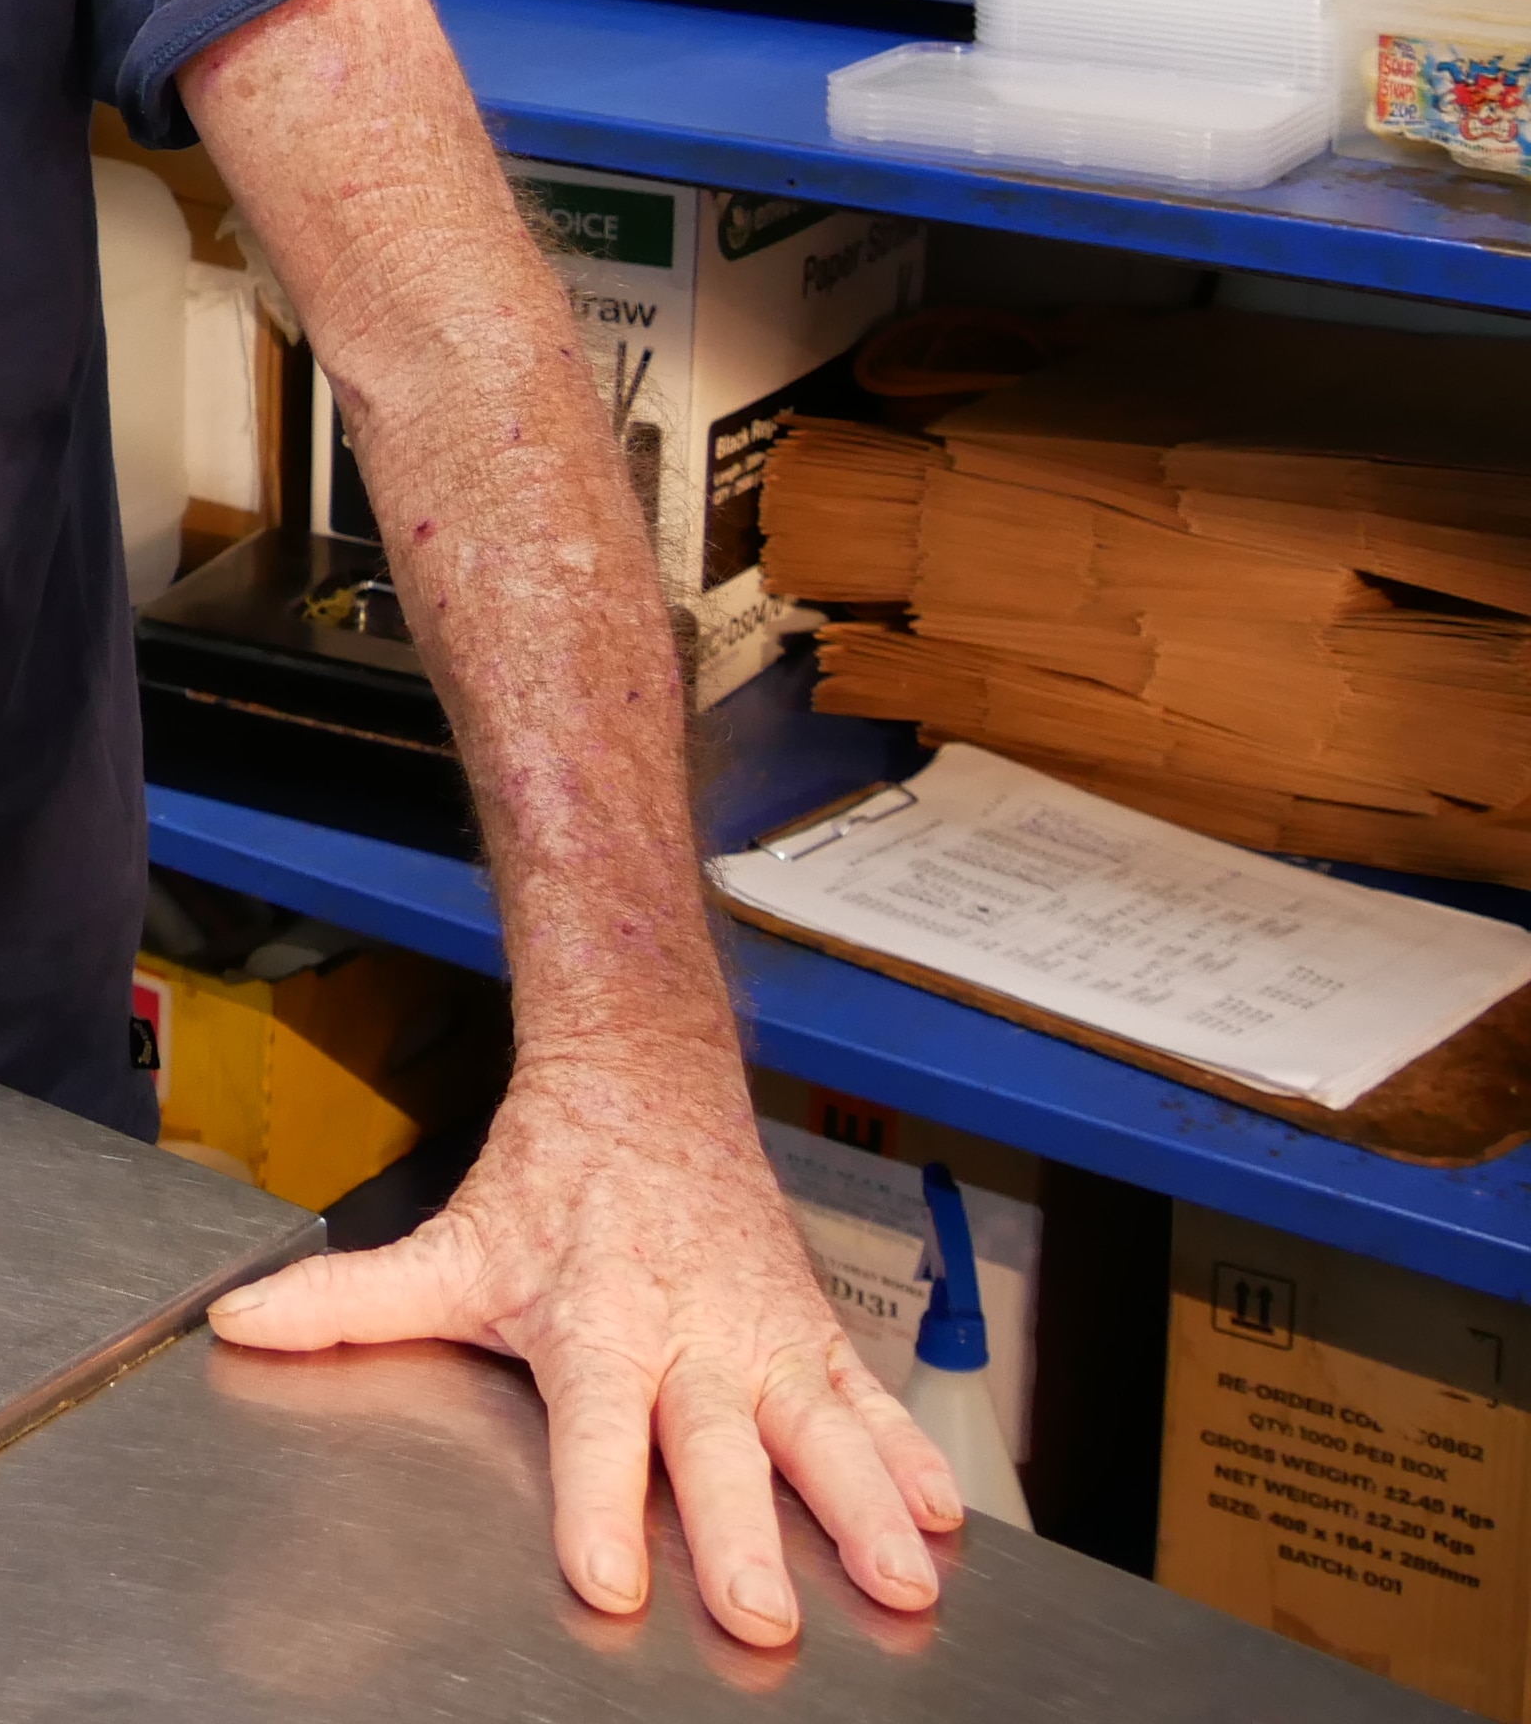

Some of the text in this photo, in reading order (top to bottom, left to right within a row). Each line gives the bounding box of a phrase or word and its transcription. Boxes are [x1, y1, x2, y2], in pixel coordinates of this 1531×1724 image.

[1217, 1371, 1335, 1419] RE-ORDER
[1199, 1429, 1277, 1465] GROSS
[1280, 1452, 1378, 1495] WEIGHT:
[1450, 1503, 1496, 1531] Kgs
[1247, 1412, 1448, 1483] QTY: 1000 PER BOX
[1207, 1491, 1261, 1521] SIZE:
[1313, 1527, 1328, 1543] x
[1379, 1545, 1394, 1562] x
[1214, 1463, 1260, 1489] NET
[1263, 1477, 1359, 1520] WEIGHT:
[1432, 1529, 1476, 1557] Kgs
[1277, 1543, 1404, 1596] BATCH: 001
